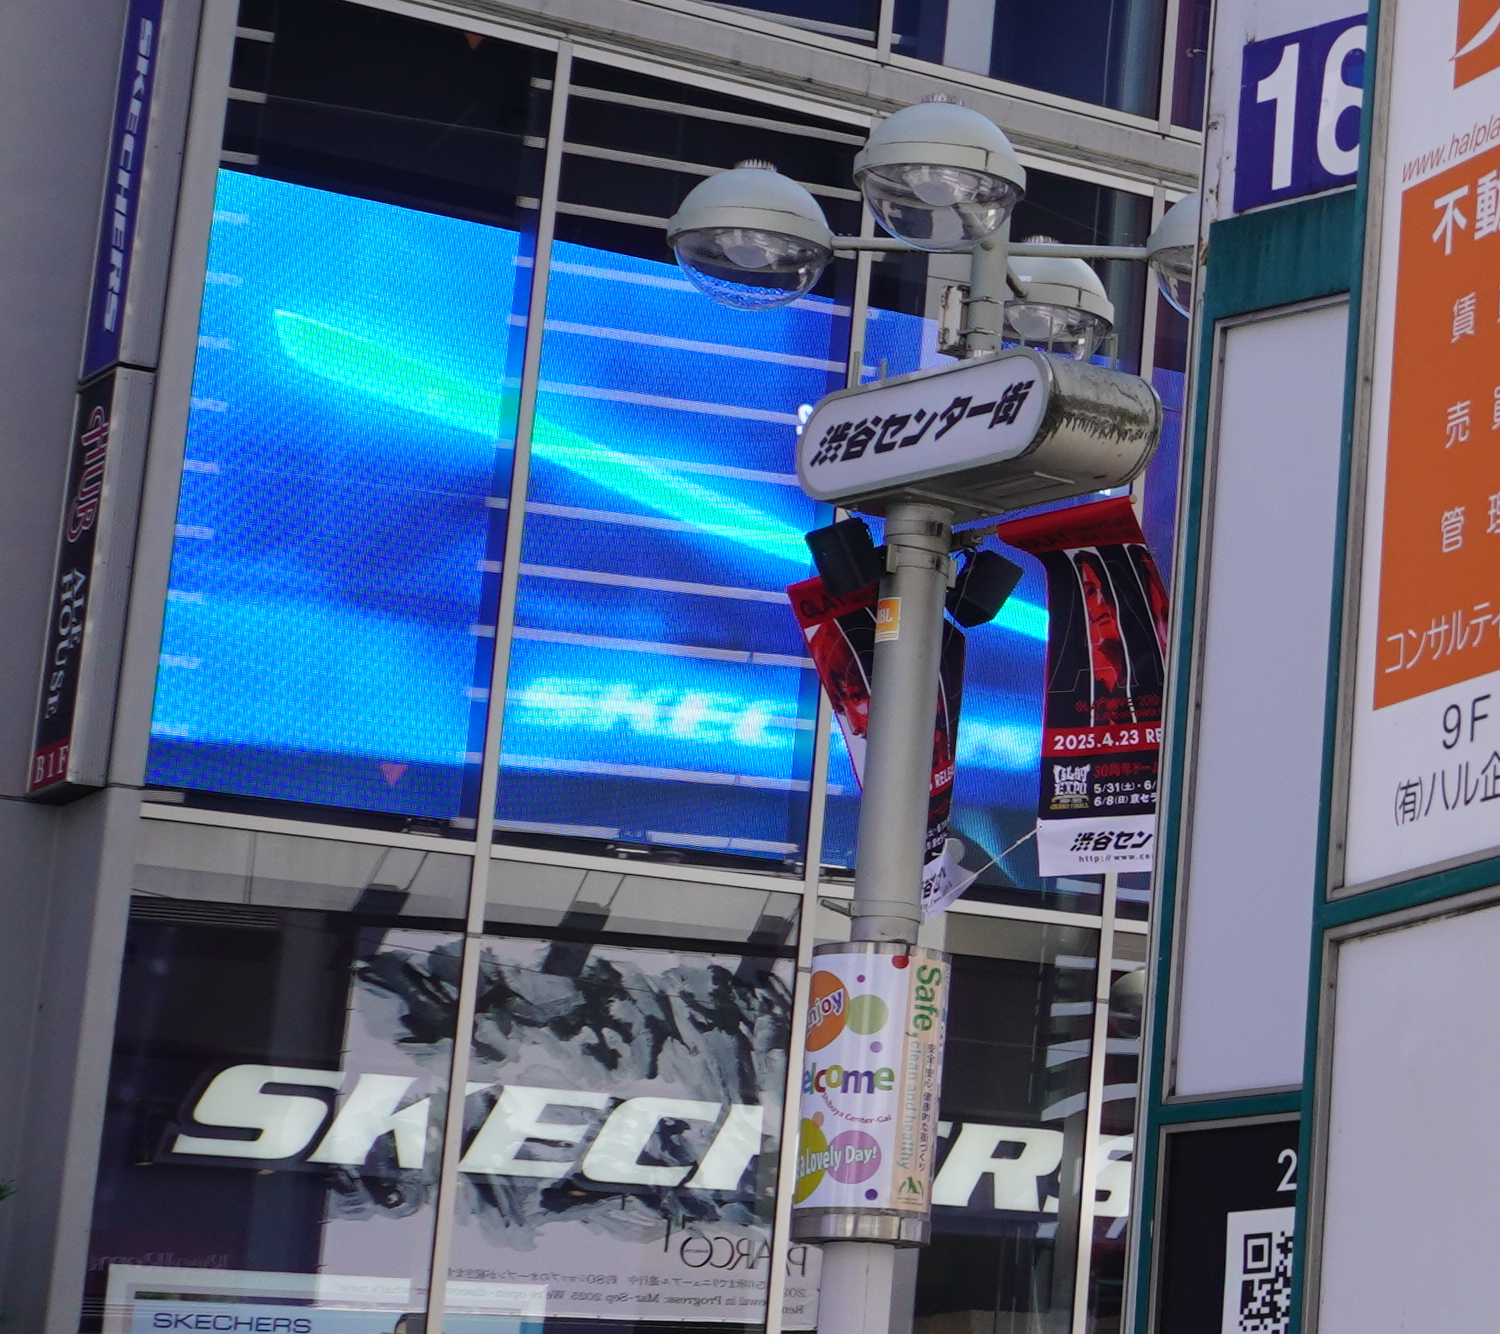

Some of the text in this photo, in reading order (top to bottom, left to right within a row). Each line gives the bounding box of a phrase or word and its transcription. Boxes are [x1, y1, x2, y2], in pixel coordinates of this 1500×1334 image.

[105, 17, 153, 333] SKECHERS
[810, 380, 1036, 467] 渋谷センター街
[67, 405, 107, 544] HUB
[45, 569, 75, 719] HOUSE
[1053, 729, 1140, 751] 2025.4.23
[1442, 693, 1492, 751] 9F
[33, 744, 70, 785] B1F
[1053, 781, 1088, 796] EXPO
[1070, 830, 1153, 852] 渋谷セン
[803, 1064, 895, 1095] elcome
[896, 964, 941, 1171] Safe, clean and healthy
[821, 1092, 846, 1119] Shibuya
[806, 1143, 877, 1172] Lovely Day!
[152, 1312, 313, 1334] SKECHERS
